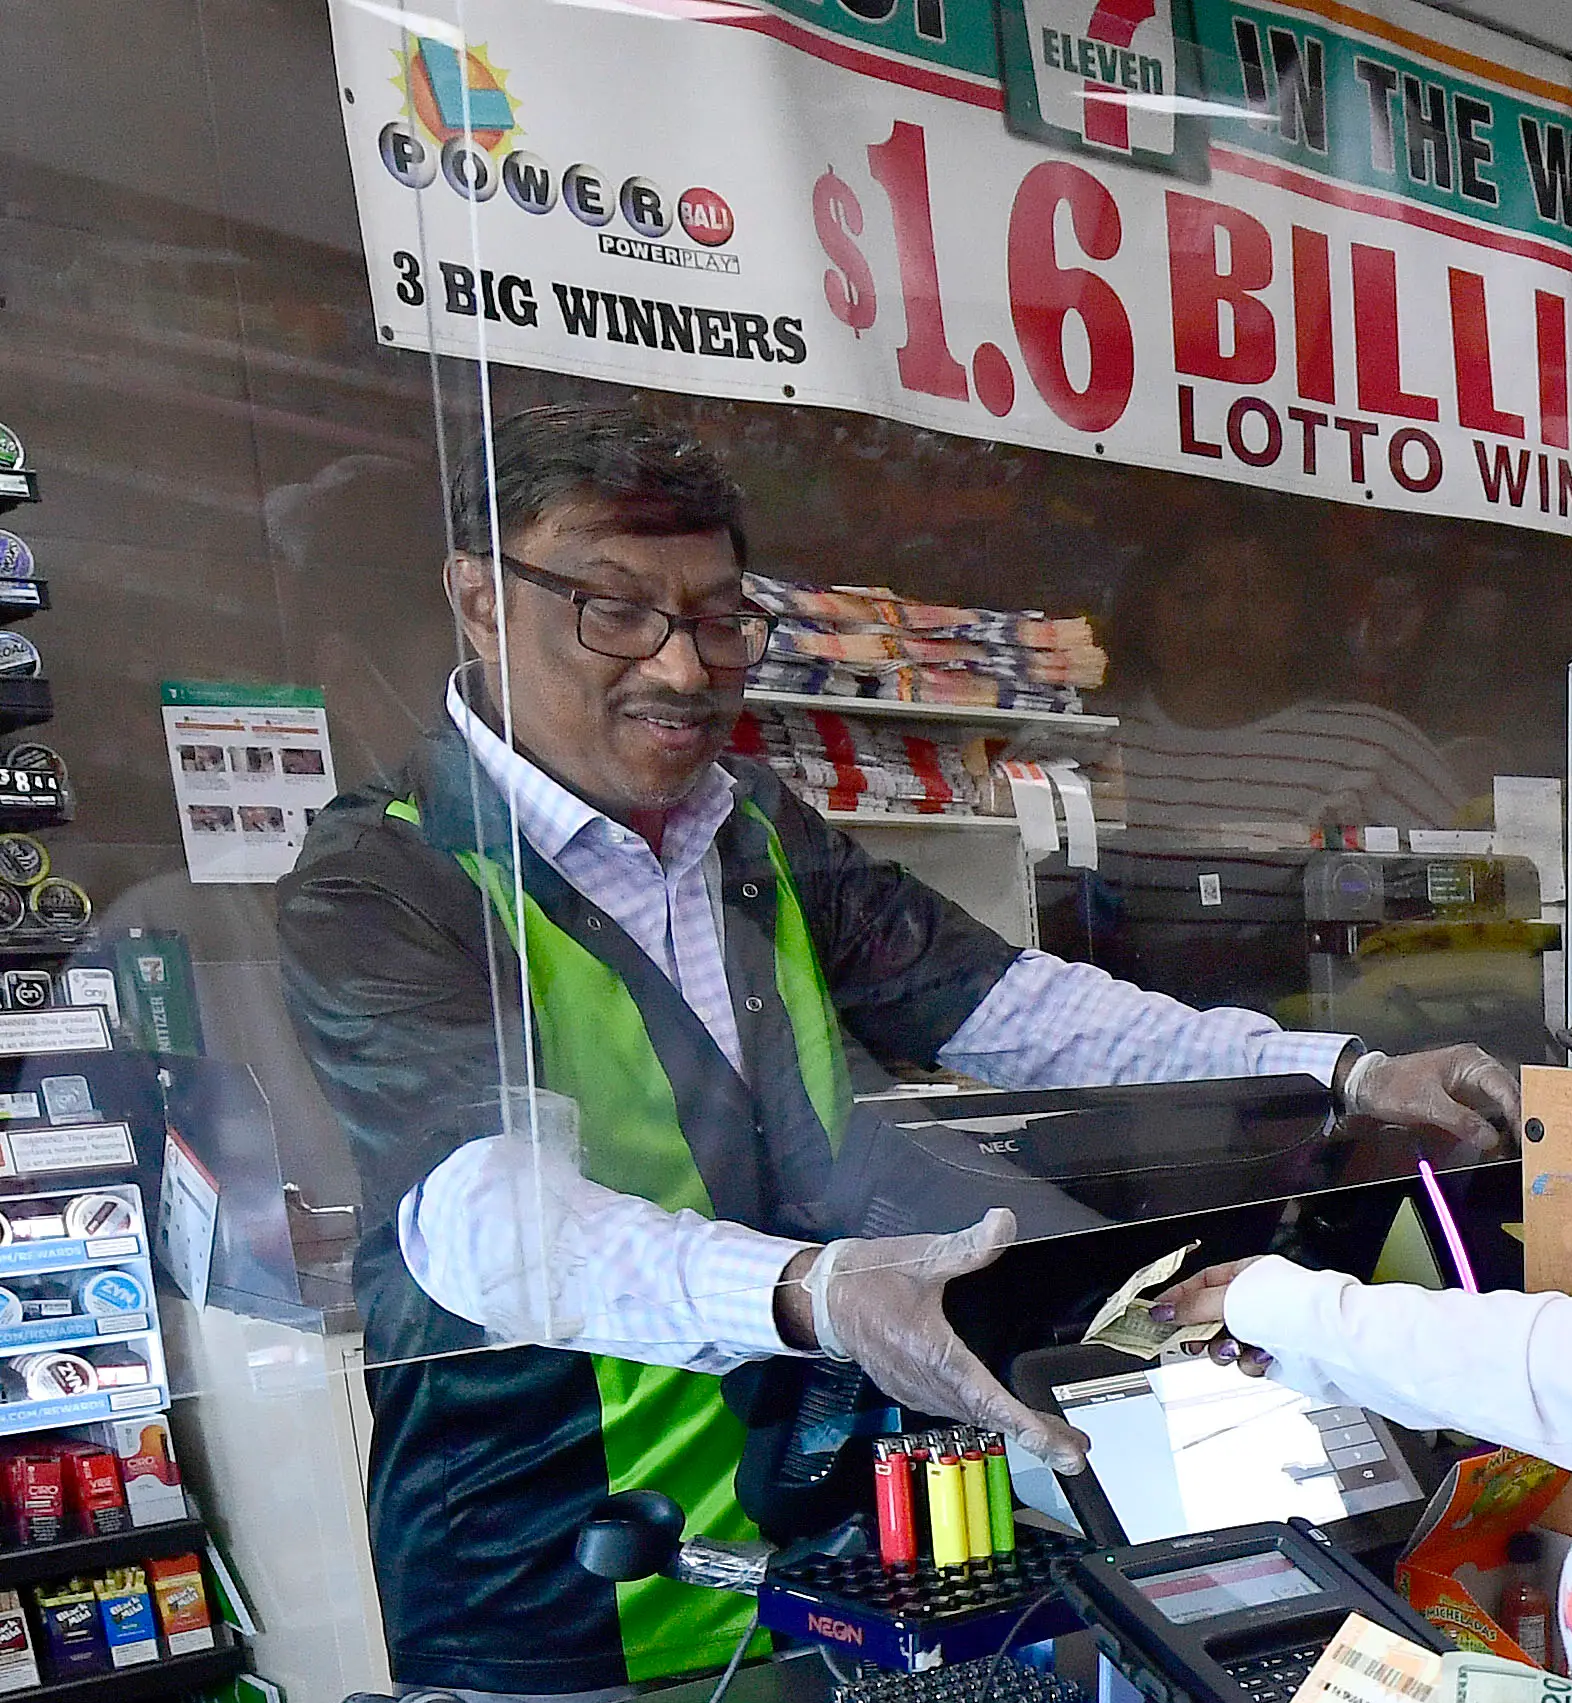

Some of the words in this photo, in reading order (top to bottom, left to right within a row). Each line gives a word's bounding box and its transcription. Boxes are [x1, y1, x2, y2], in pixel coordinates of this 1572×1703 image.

[1043, 27, 1163, 92] ELEVEN
[1232, 18, 1328, 154] IN
[1354, 55, 1499, 206] THE
[393, 250, 424, 307] 3
[439, 260, 539, 328] BIG
[552, 282, 807, 365] WINNERS
[812, 119, 1135, 433] $1.6
[1178, 384, 1444, 494] LOTTO
[100, 1278, 138, 1310] ZYN
[57, 1362, 88, 1395] ZYN
[807, 1612, 865, 1647] NEON
